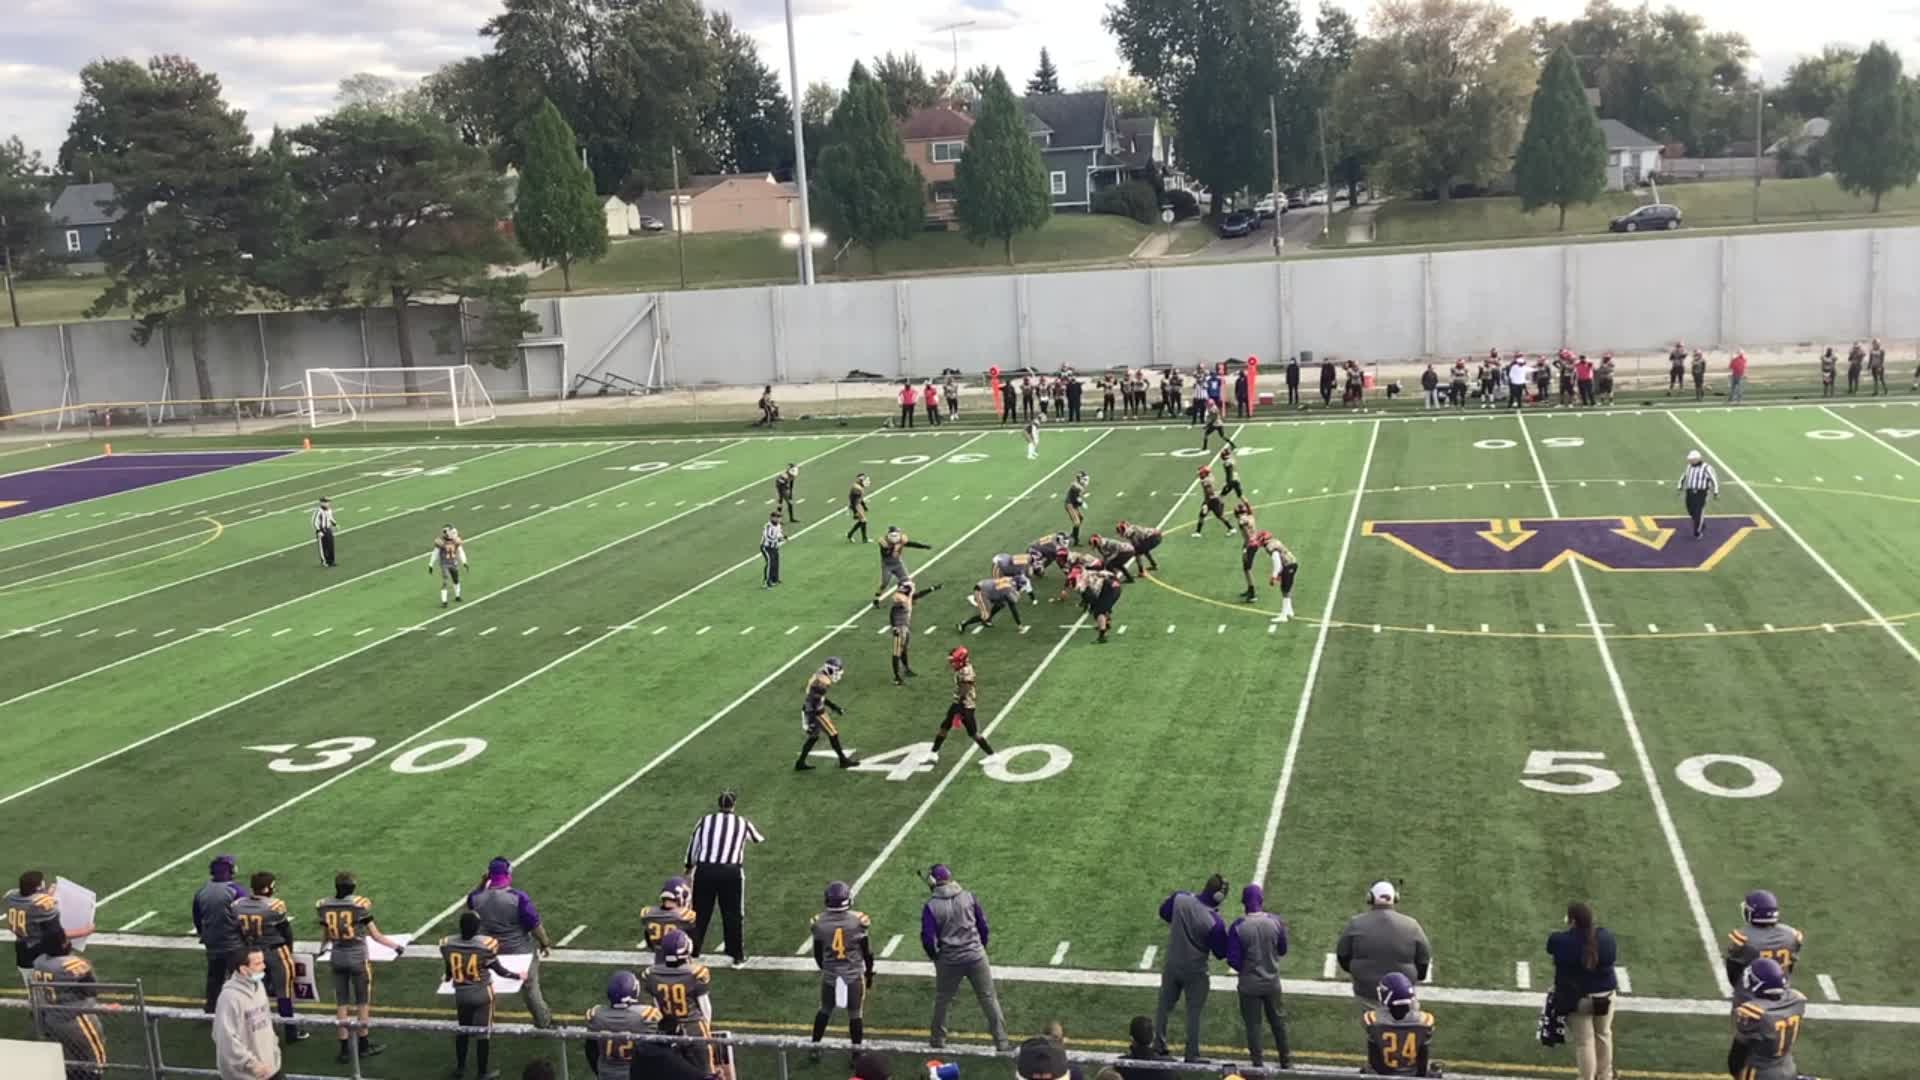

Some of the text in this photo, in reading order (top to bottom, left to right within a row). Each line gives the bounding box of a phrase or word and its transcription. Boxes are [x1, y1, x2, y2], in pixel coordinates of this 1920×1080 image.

[267, 736, 488, 773] 30
[1518, 750, 1784, 798] 50
[325, 910, 355, 940] 83
[831, 927, 846, 960] 4
[450, 952, 481, 983] 84
[657, 984, 688, 1016] 39
[1382, 1031, 1417, 1068] 24
[1775, 1014, 1800, 1057] 77
